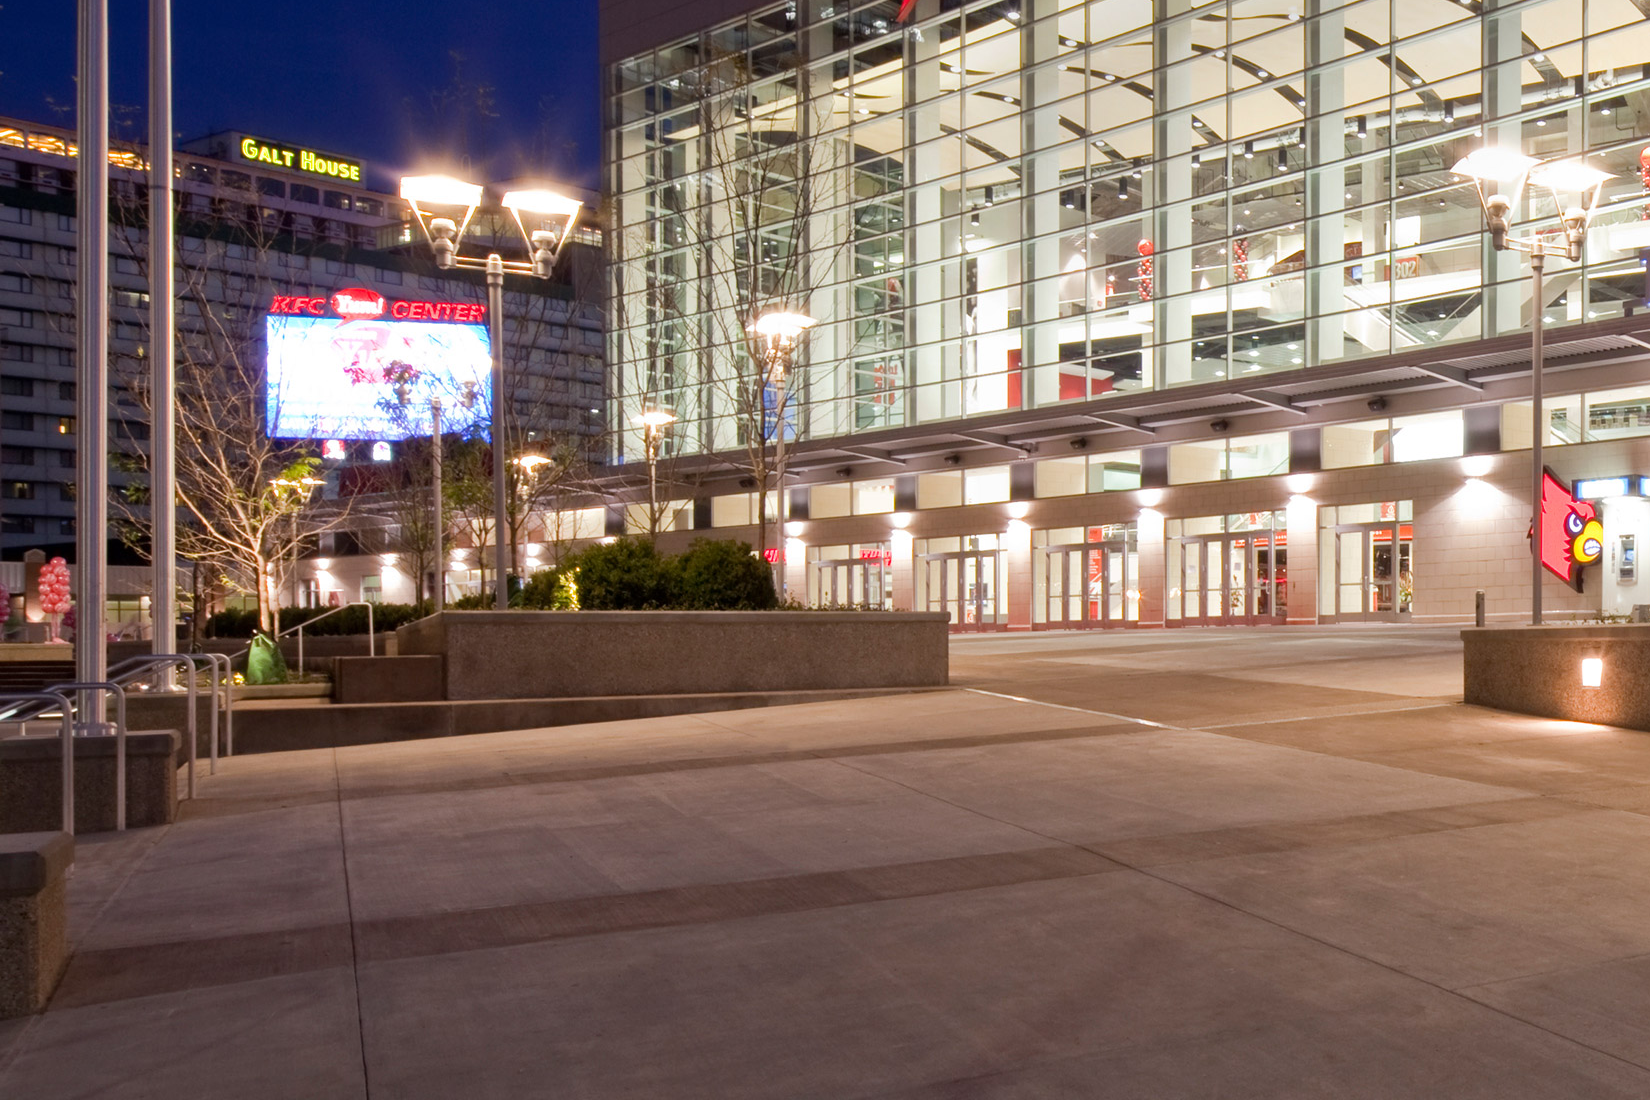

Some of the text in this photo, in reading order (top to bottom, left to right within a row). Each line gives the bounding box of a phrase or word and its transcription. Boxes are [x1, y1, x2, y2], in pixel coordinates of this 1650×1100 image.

[241, 138, 360, 181] GALT HOUSE
[271, 295, 326, 315] KFC
[391, 300, 487, 322] CENTER
